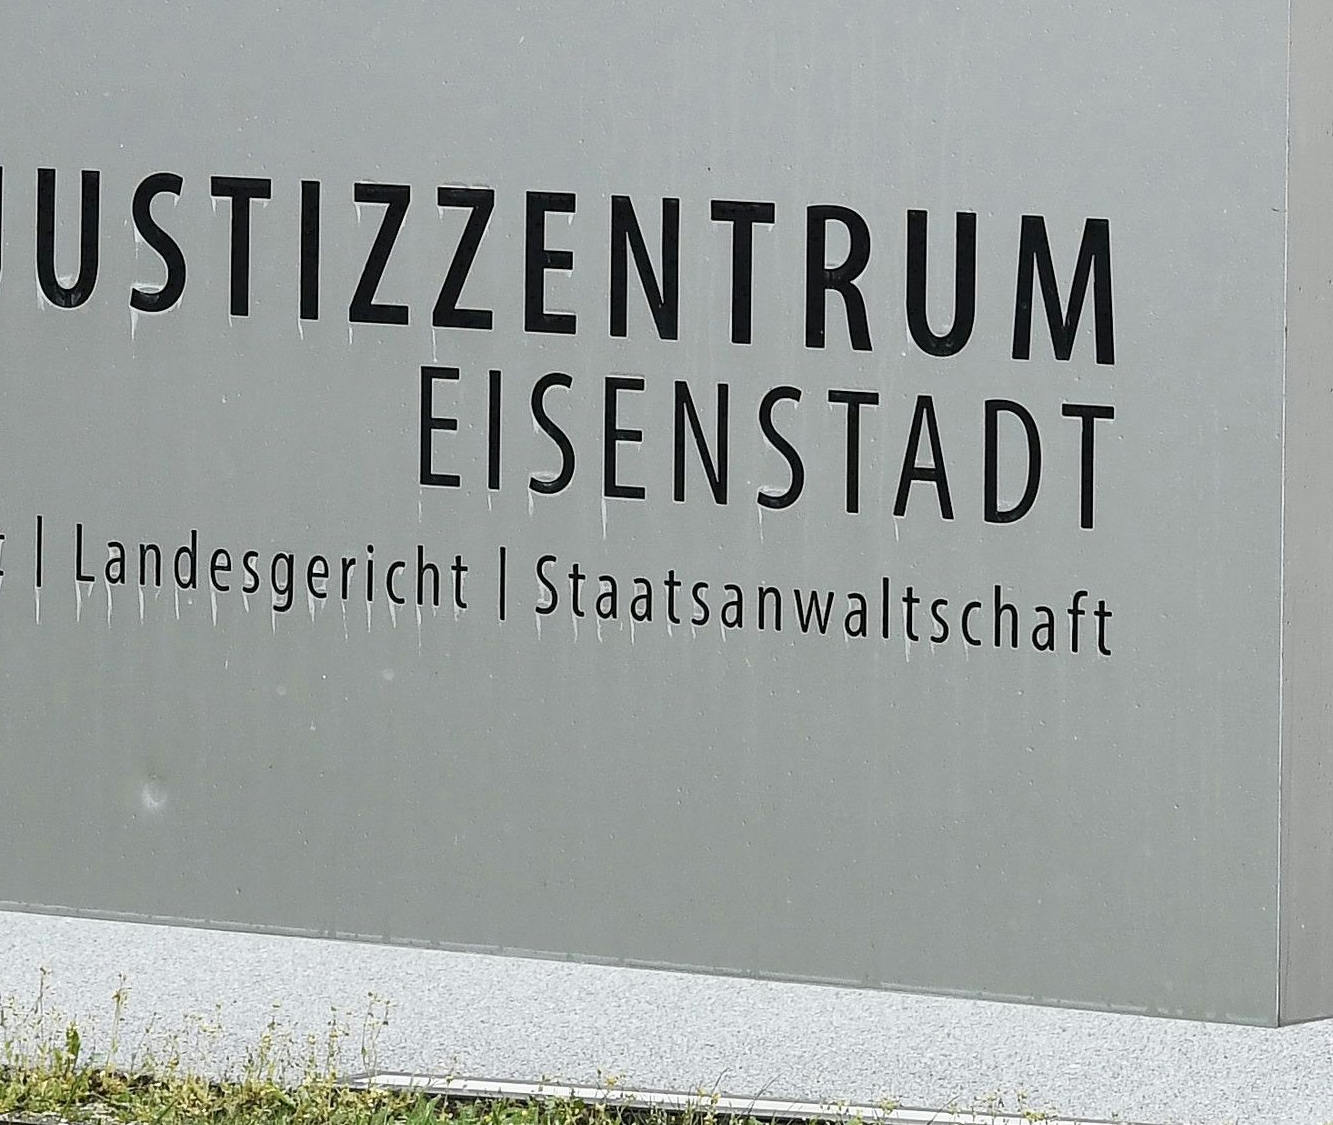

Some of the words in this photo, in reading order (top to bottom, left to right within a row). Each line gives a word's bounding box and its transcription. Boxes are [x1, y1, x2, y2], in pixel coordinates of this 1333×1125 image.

[418, 364, 1116, 530] EISENSTADT
[75, 522, 469, 614] Landesgericht
[534, 553, 1114, 657] Staatsanwaltschaft
